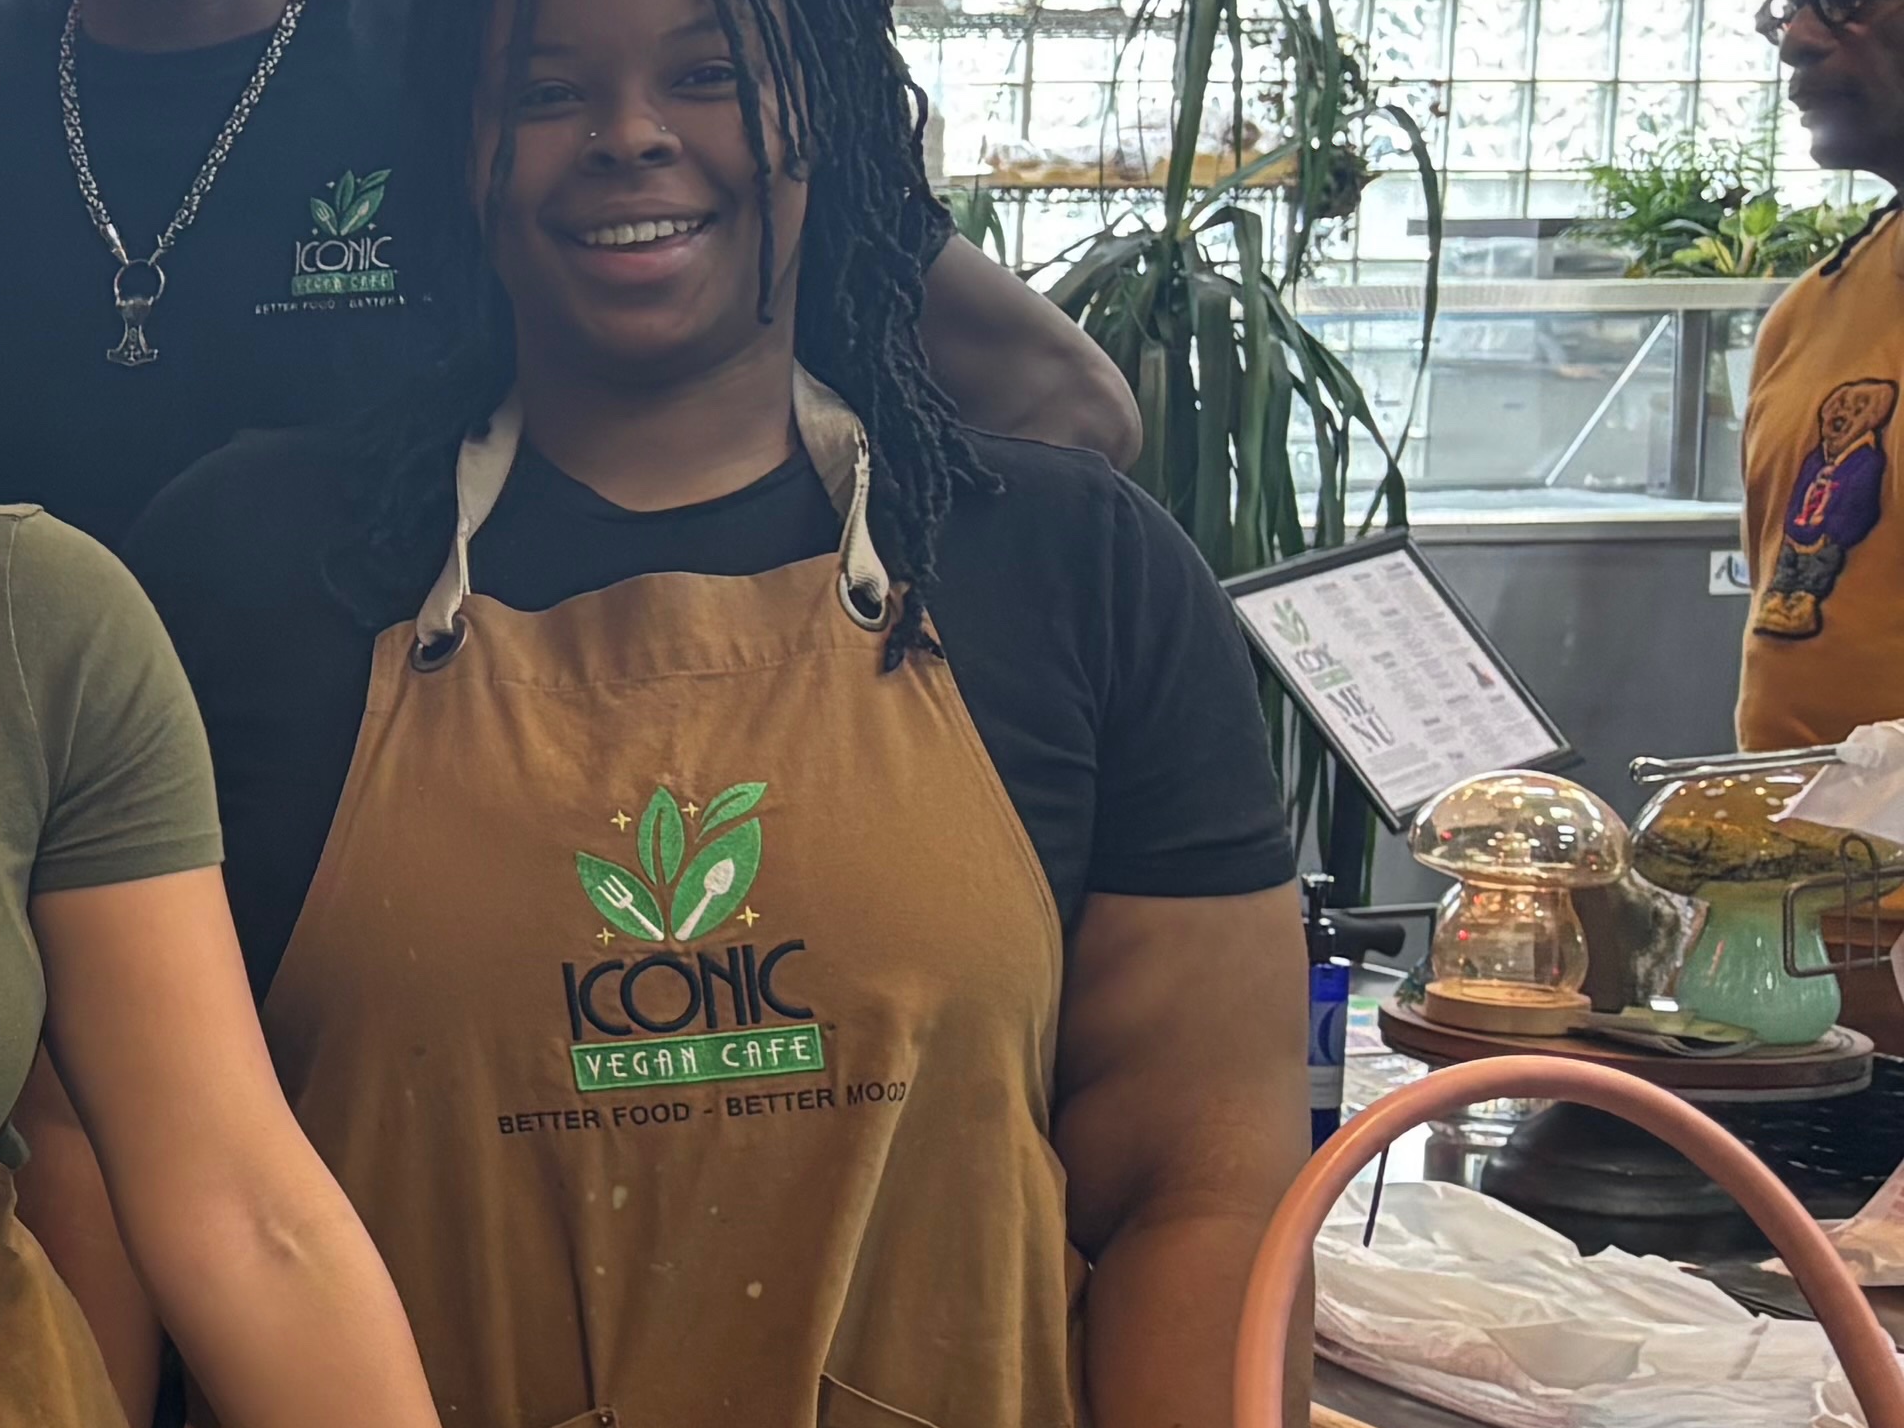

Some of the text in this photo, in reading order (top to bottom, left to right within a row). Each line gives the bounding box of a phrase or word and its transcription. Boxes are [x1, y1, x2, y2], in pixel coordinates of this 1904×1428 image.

[295, 236, 392, 274] ICONIC
[561, 939, 814, 1041] ICONIC
[585, 1035, 812, 1080] VEGAN CAFE
[497, 1109, 600, 1135] BETTER
[612, 1102, 690, 1127] FOOD
[726, 1089, 835, 1117] BETTER
[847, 1081, 907, 1105] MOOD
